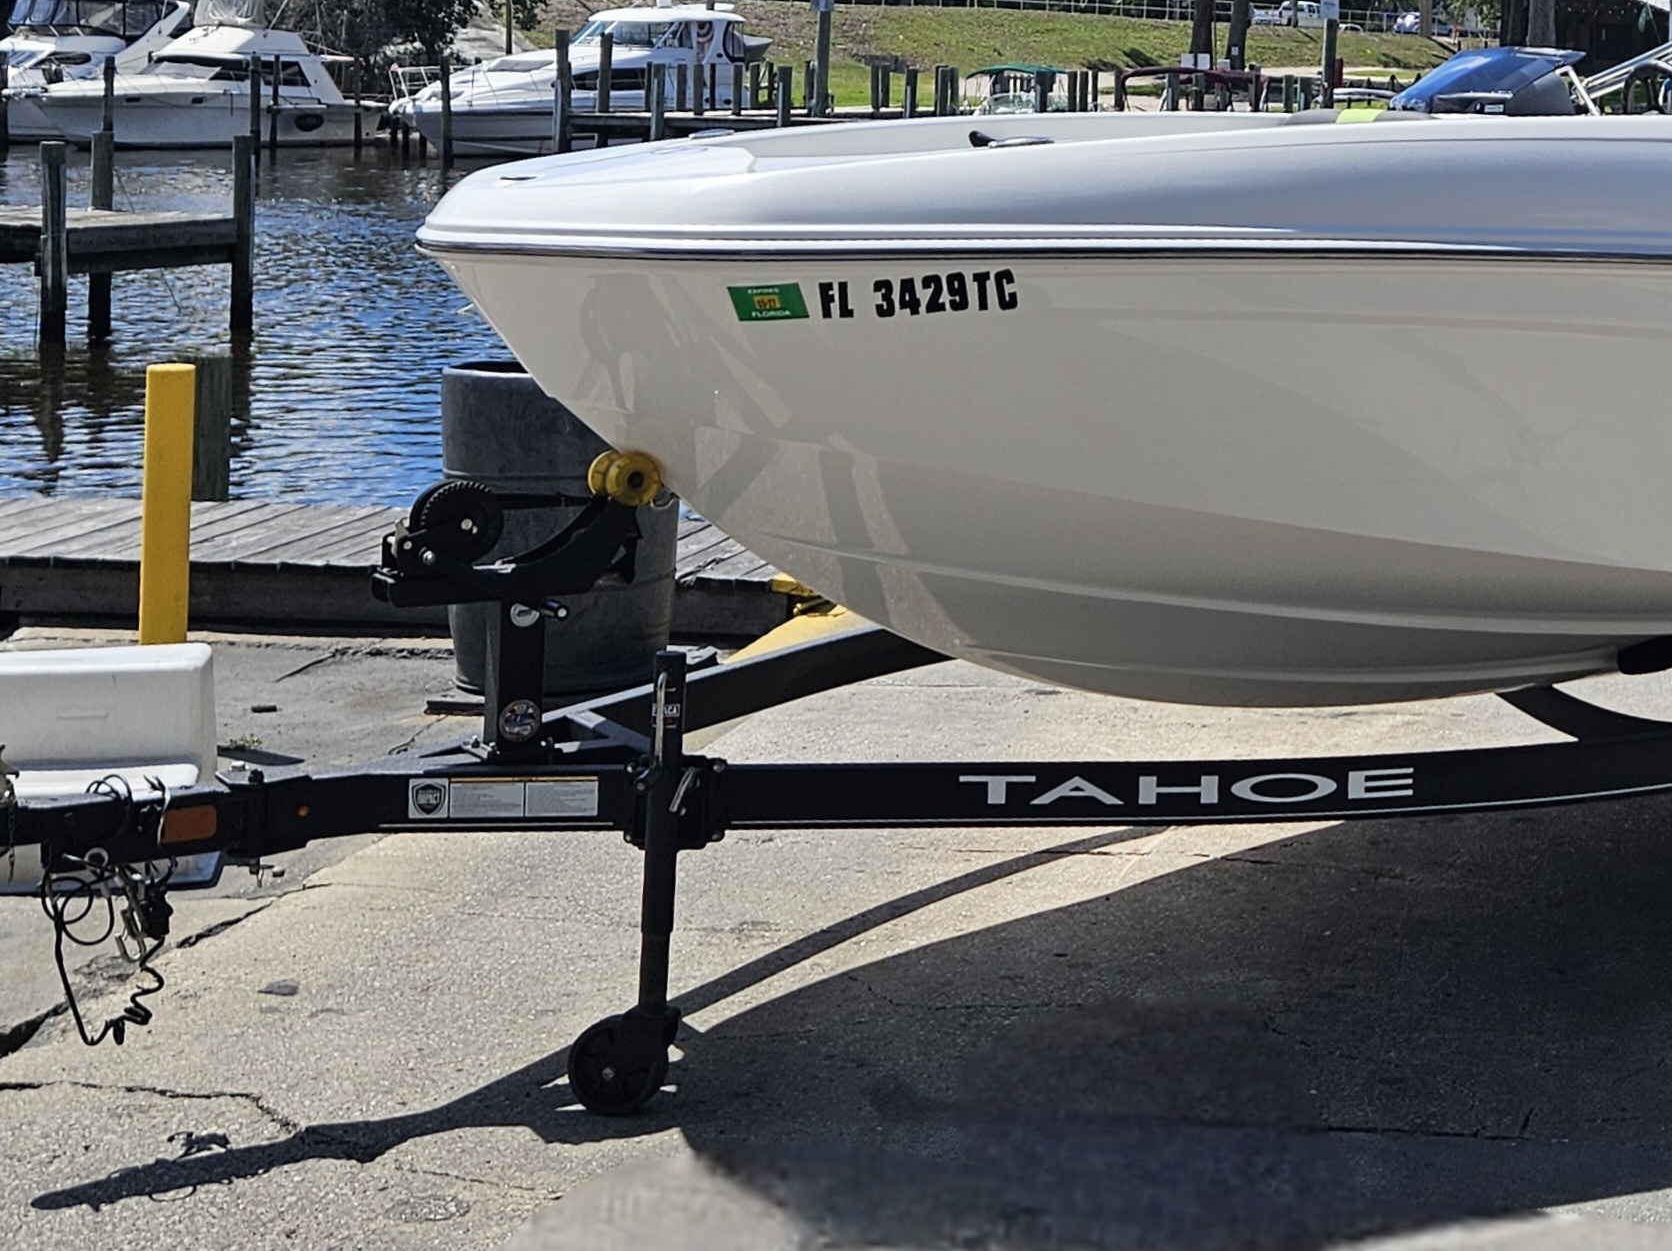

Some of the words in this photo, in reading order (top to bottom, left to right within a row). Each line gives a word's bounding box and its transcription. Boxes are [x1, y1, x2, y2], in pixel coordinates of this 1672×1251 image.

[751, 310, 791, 318] FLORIDA
[818, 281, 855, 320] FL
[958, 767, 1415, 806] TAHOE
